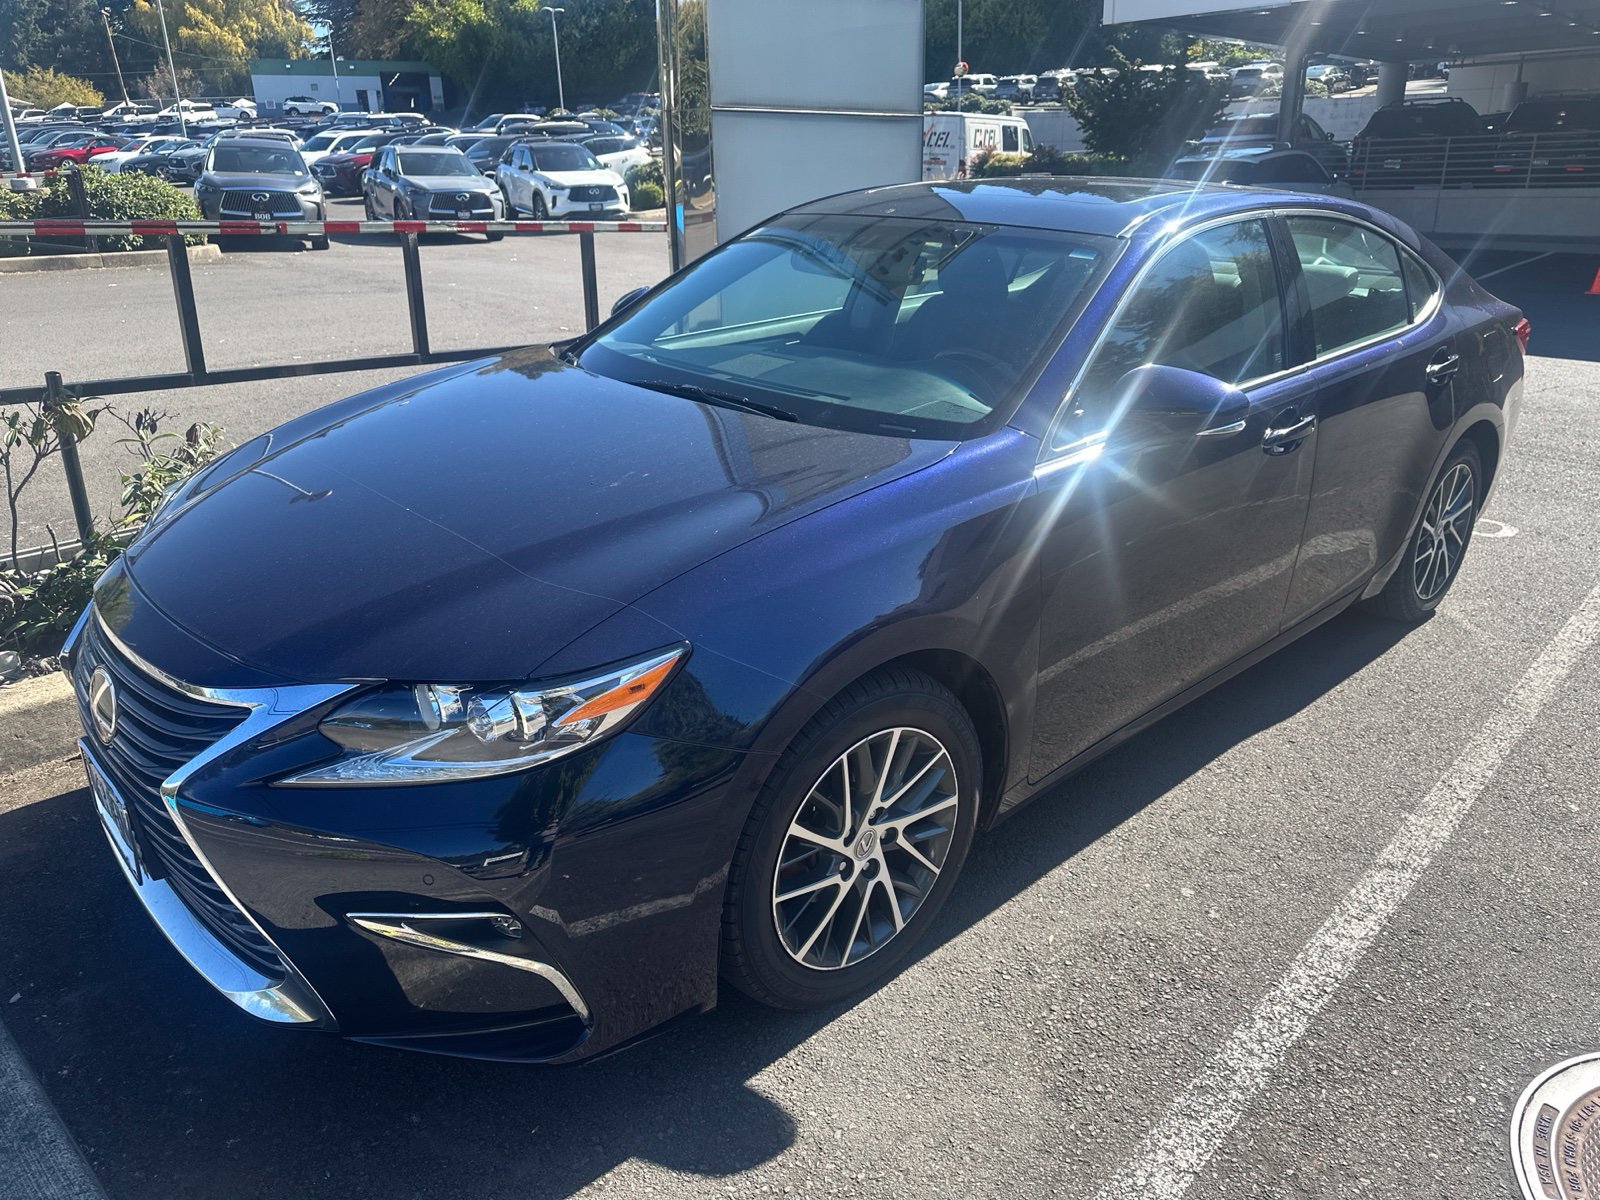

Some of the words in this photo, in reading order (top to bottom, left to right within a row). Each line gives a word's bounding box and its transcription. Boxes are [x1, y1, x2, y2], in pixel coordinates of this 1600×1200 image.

[1535, 1114, 1553, 1142] MADE
[1535, 1145, 1548, 1159] IN
[1537, 1163, 1553, 1185] USA
[1567, 1170, 1583, 1192] FOR
